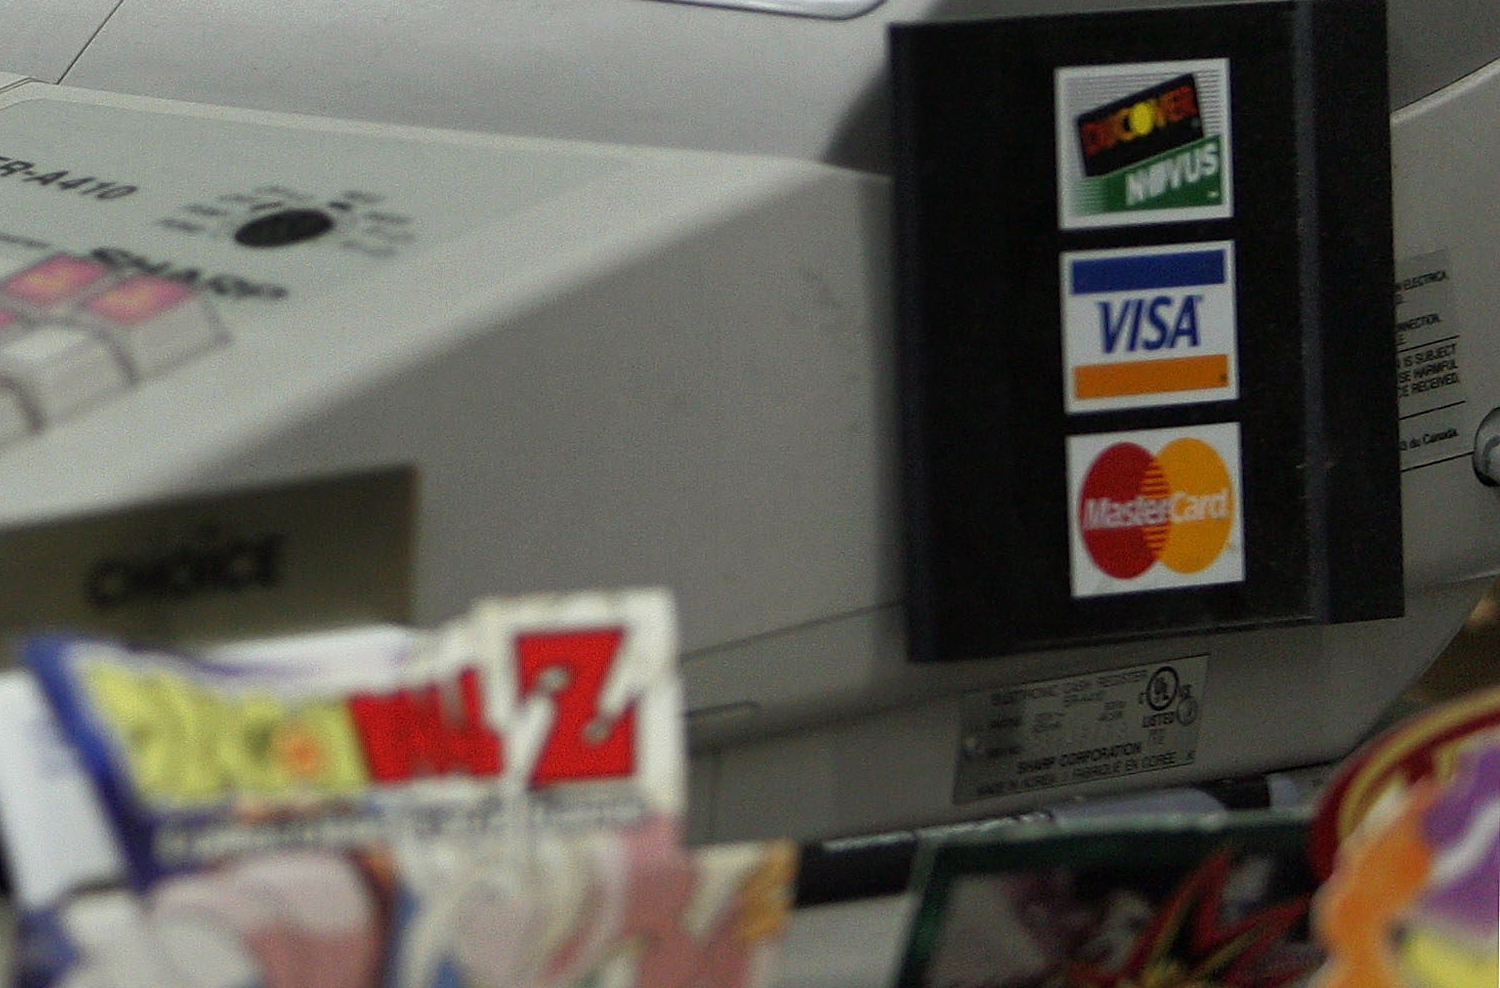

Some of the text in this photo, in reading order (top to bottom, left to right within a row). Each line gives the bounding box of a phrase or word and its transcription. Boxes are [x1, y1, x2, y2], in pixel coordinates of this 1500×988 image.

[1096, 294, 1203, 354] VISA
[1415, 343, 1457, 363] SUBJECT
[1083, 489, 1231, 531] MasterCard
[516, 631, 639, 790] Z
